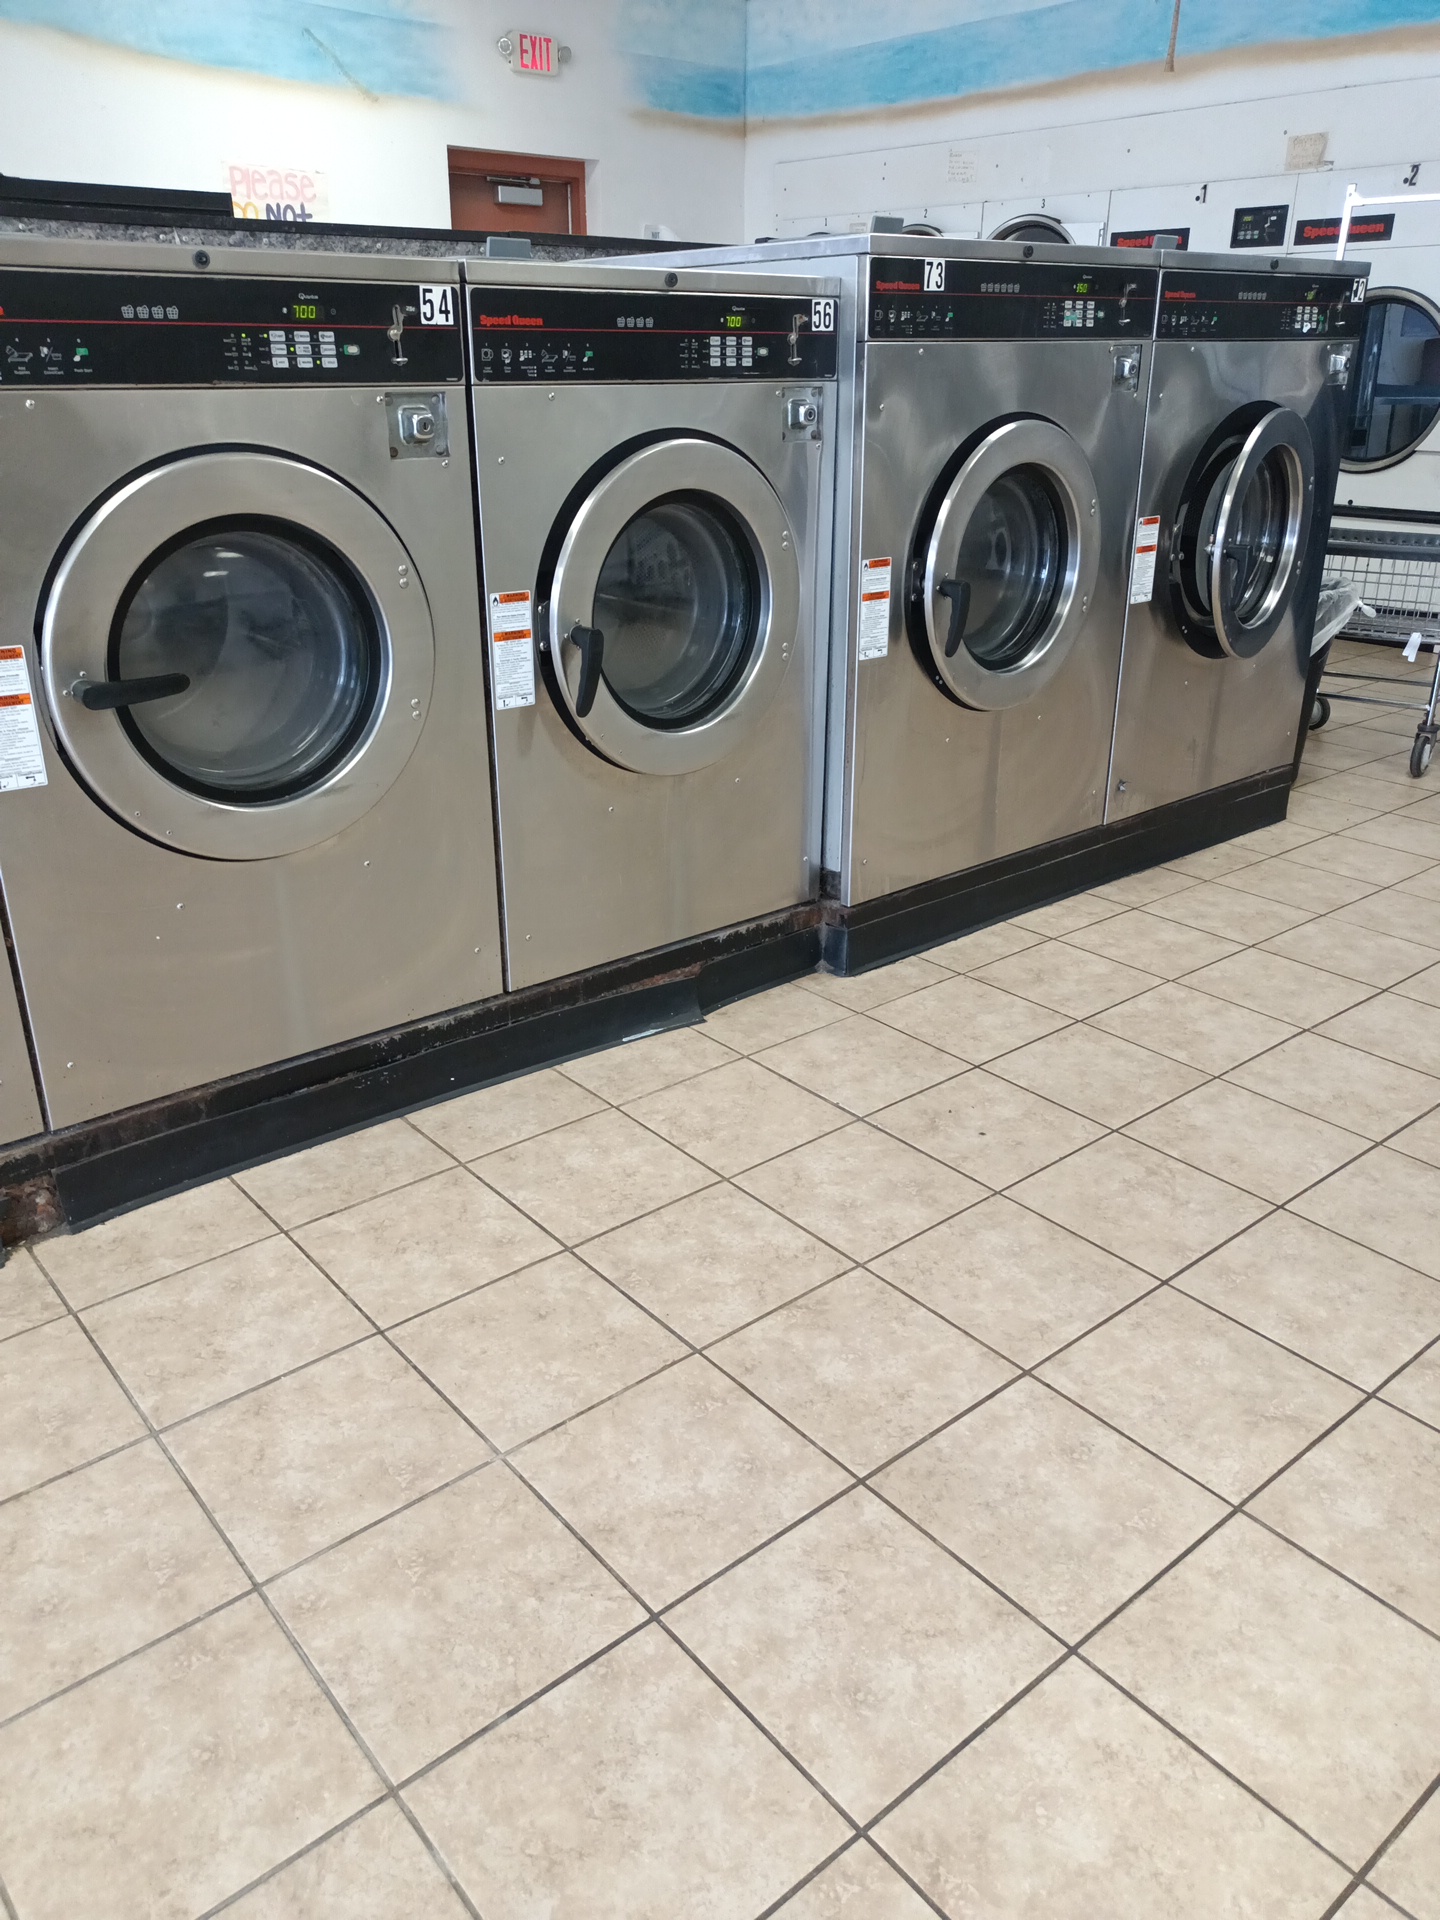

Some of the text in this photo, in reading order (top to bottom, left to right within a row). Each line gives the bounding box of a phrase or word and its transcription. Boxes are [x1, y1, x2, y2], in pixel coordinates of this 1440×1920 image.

[519, 33, 552, 72] EXIT
[1408, 164, 1420, 187] 2
[1200, 184, 1208, 203] 1
[1040, 198, 1046, 209] 3
[923, 208, 929, 219] 2
[1348, 223, 1385, 235] ueen
[925, 261, 944, 290] 73
[293, 305, 316, 319] 700
[421, 288, 452, 322] 54
[480, 314, 544, 327] Speed Queen
[726, 316, 742, 328] 700
[813, 301, 832, 330] 56
